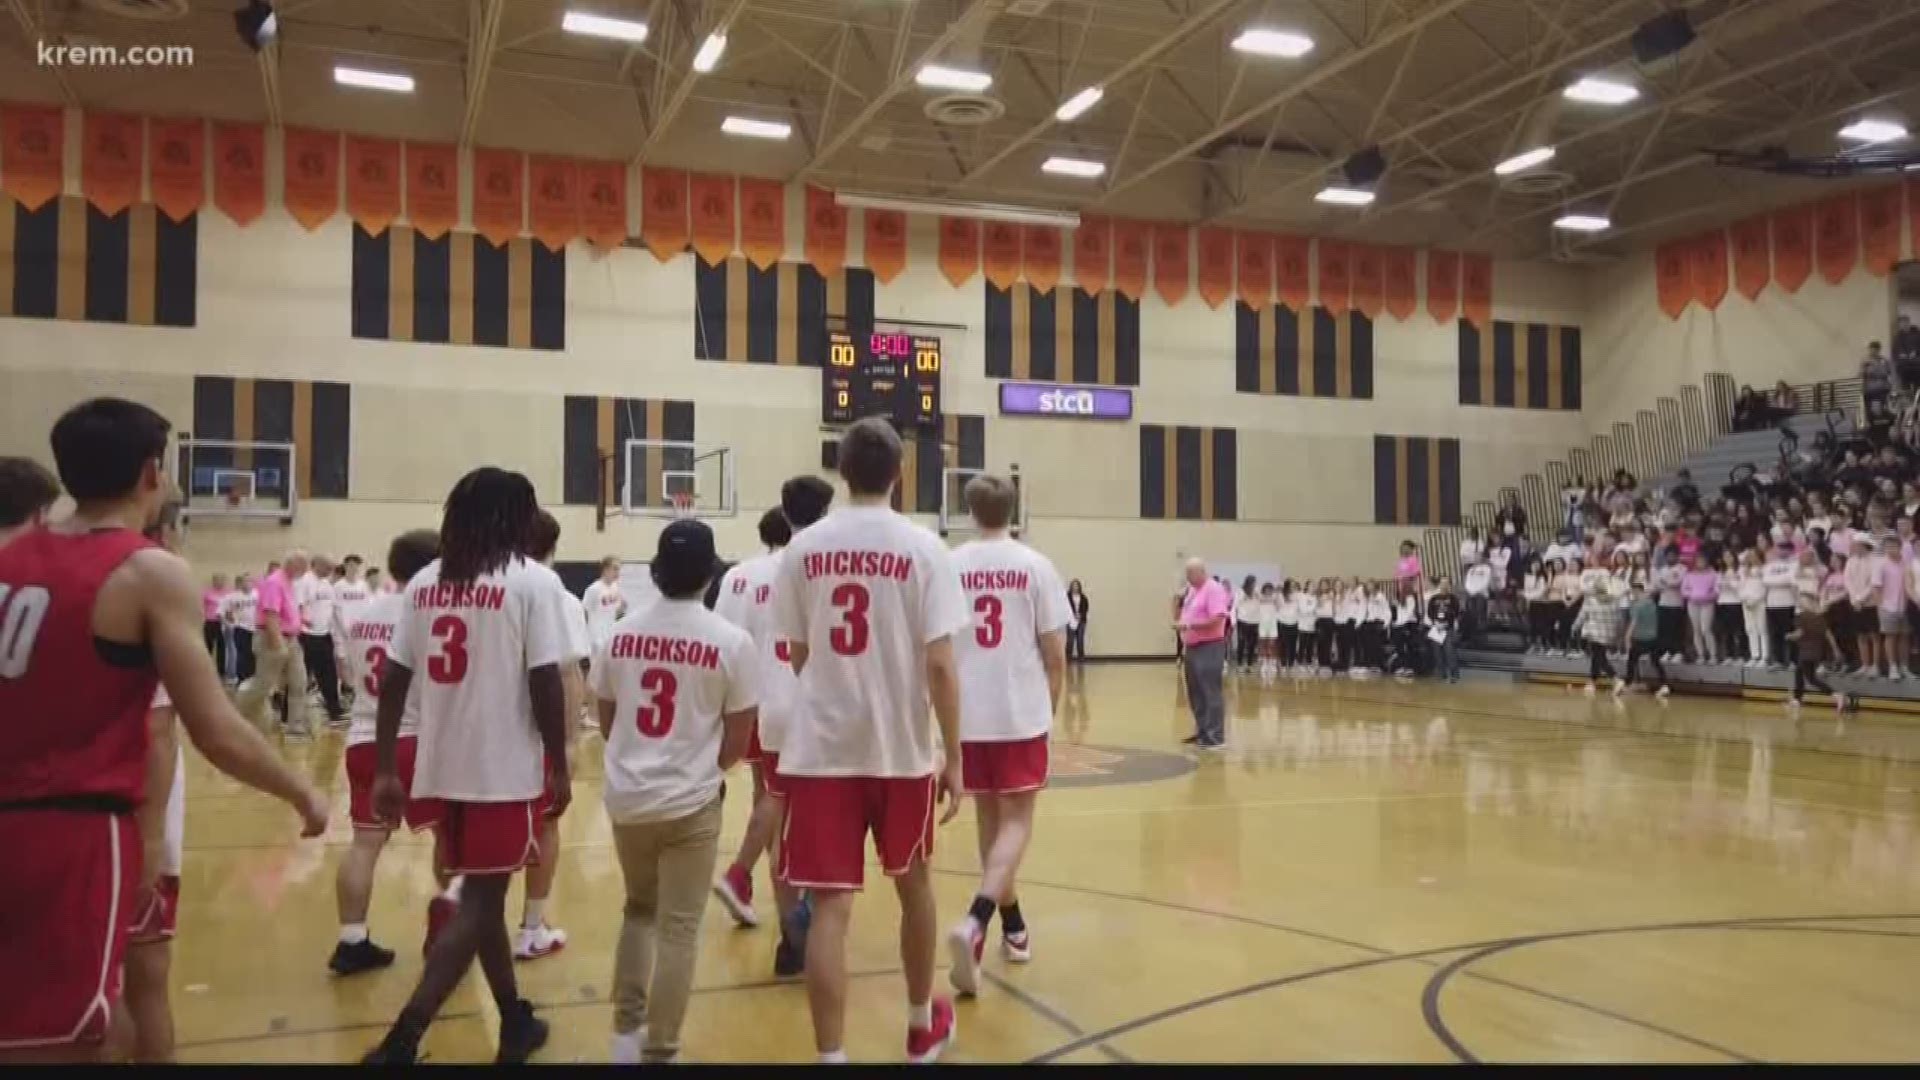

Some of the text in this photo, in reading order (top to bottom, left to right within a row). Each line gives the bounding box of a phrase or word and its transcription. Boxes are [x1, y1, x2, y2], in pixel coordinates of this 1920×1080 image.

[831, 345, 854, 365] 00
[870, 334, 909, 354] 0:00
[916, 351, 939, 371] 00
[838, 391, 848, 407] 0
[922, 395, 931, 411] 0
[1038, 389, 1094, 415] stcu
[804, 550, 913, 582] ERICKSON
[0, 583, 51, 678] 0
[829, 582, 871, 656] 3
[974, 594, 1003, 648] 3
[427, 616, 468, 684] 3
[611, 633, 720, 670] ERICKSON
[364, 646, 388, 698] 3
[636, 667, 678, 737] 3
